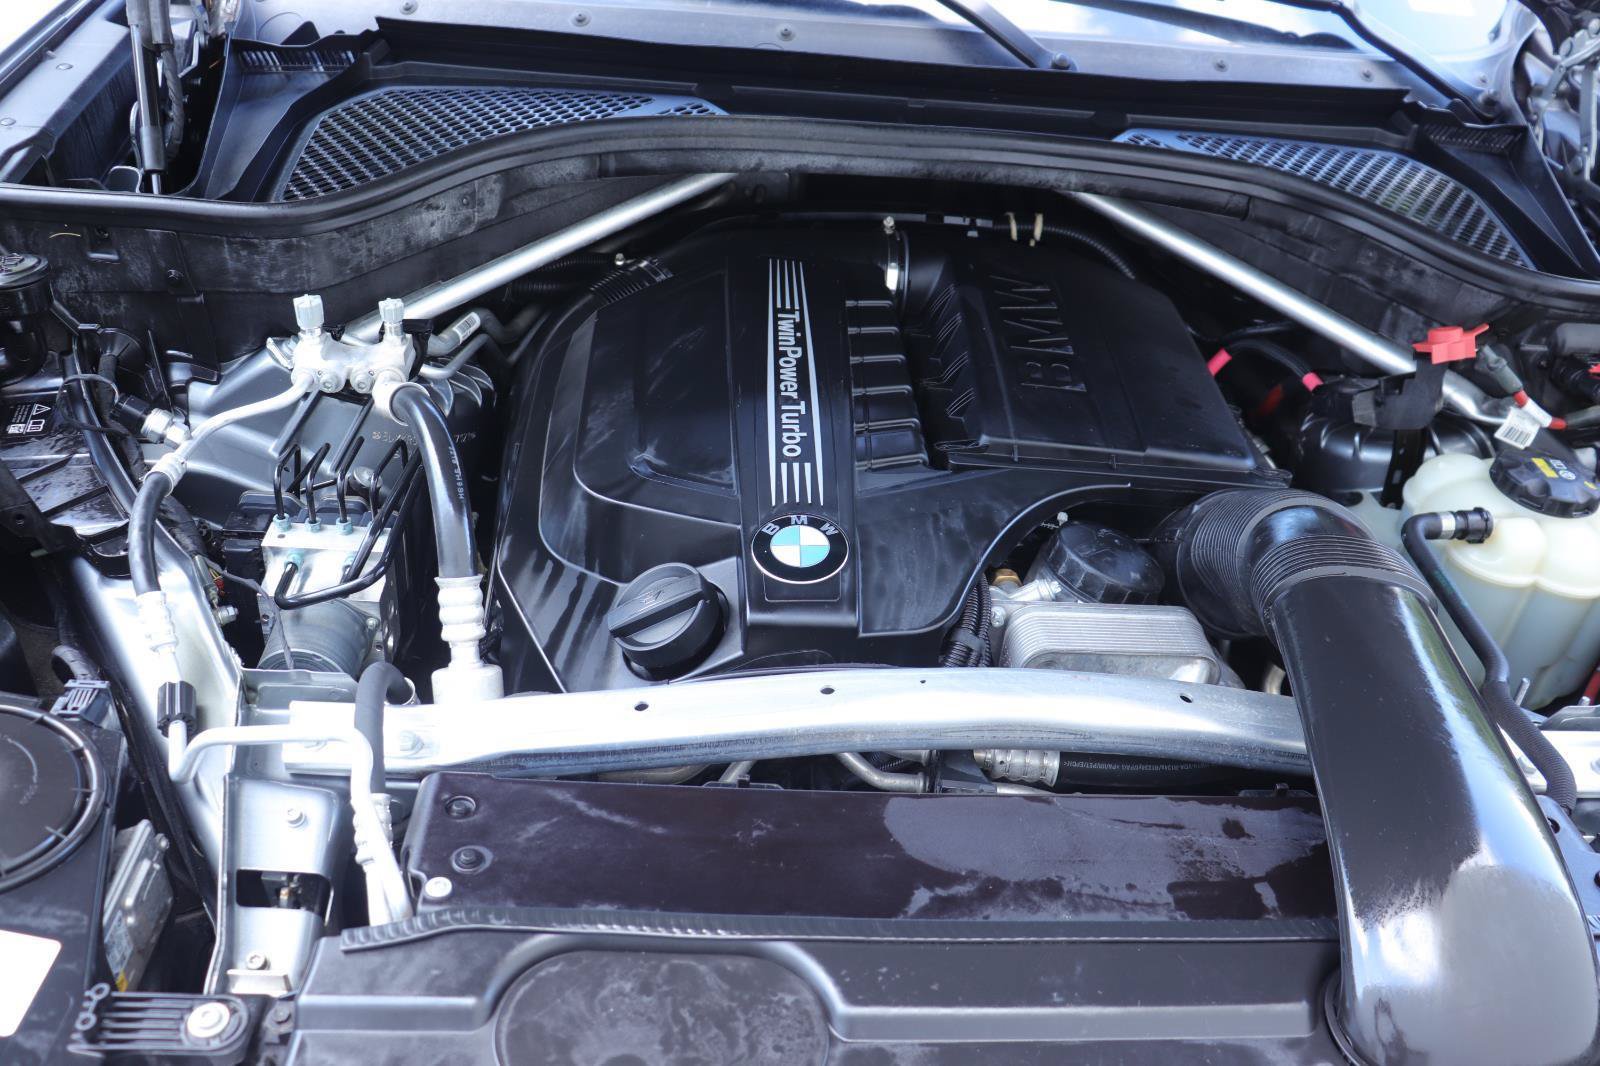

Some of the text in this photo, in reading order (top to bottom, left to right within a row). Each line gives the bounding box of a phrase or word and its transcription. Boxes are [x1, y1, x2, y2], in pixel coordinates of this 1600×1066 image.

[777, 310, 808, 458] TwinPower Turbo
[988, 274, 1088, 393] BMW
[760, 514, 839, 536] BMW
